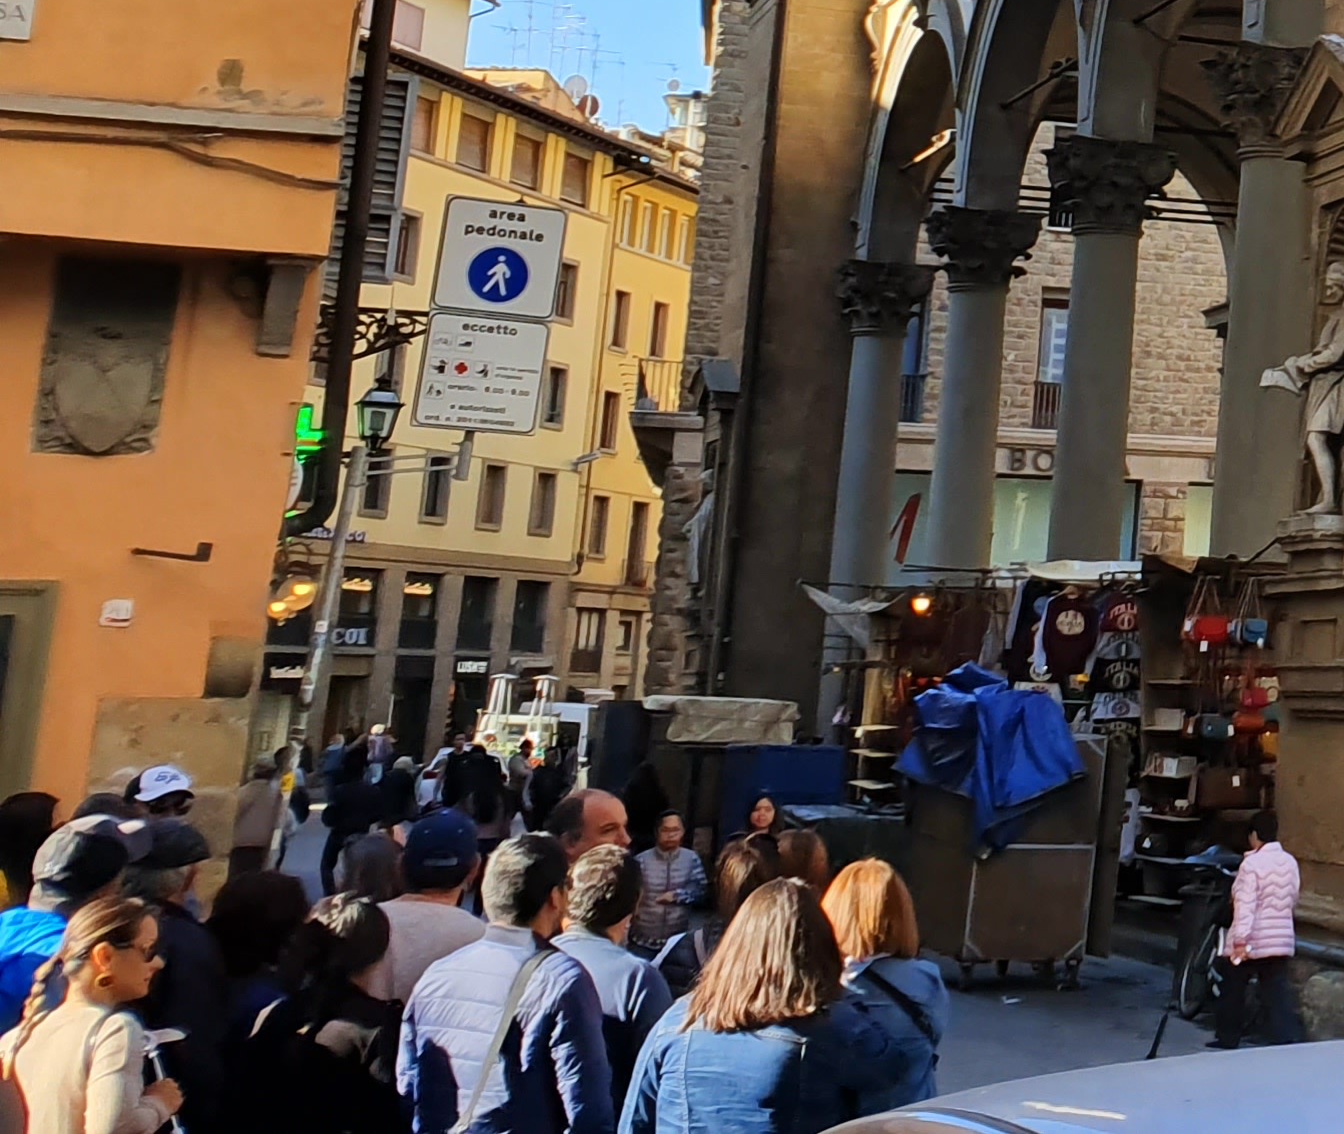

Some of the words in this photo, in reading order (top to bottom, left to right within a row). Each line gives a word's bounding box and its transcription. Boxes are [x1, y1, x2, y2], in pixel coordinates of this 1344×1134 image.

[488, 209, 526, 222] area
[464, 224, 544, 242] pedonale
[461, 322, 518, 337] eccetto
